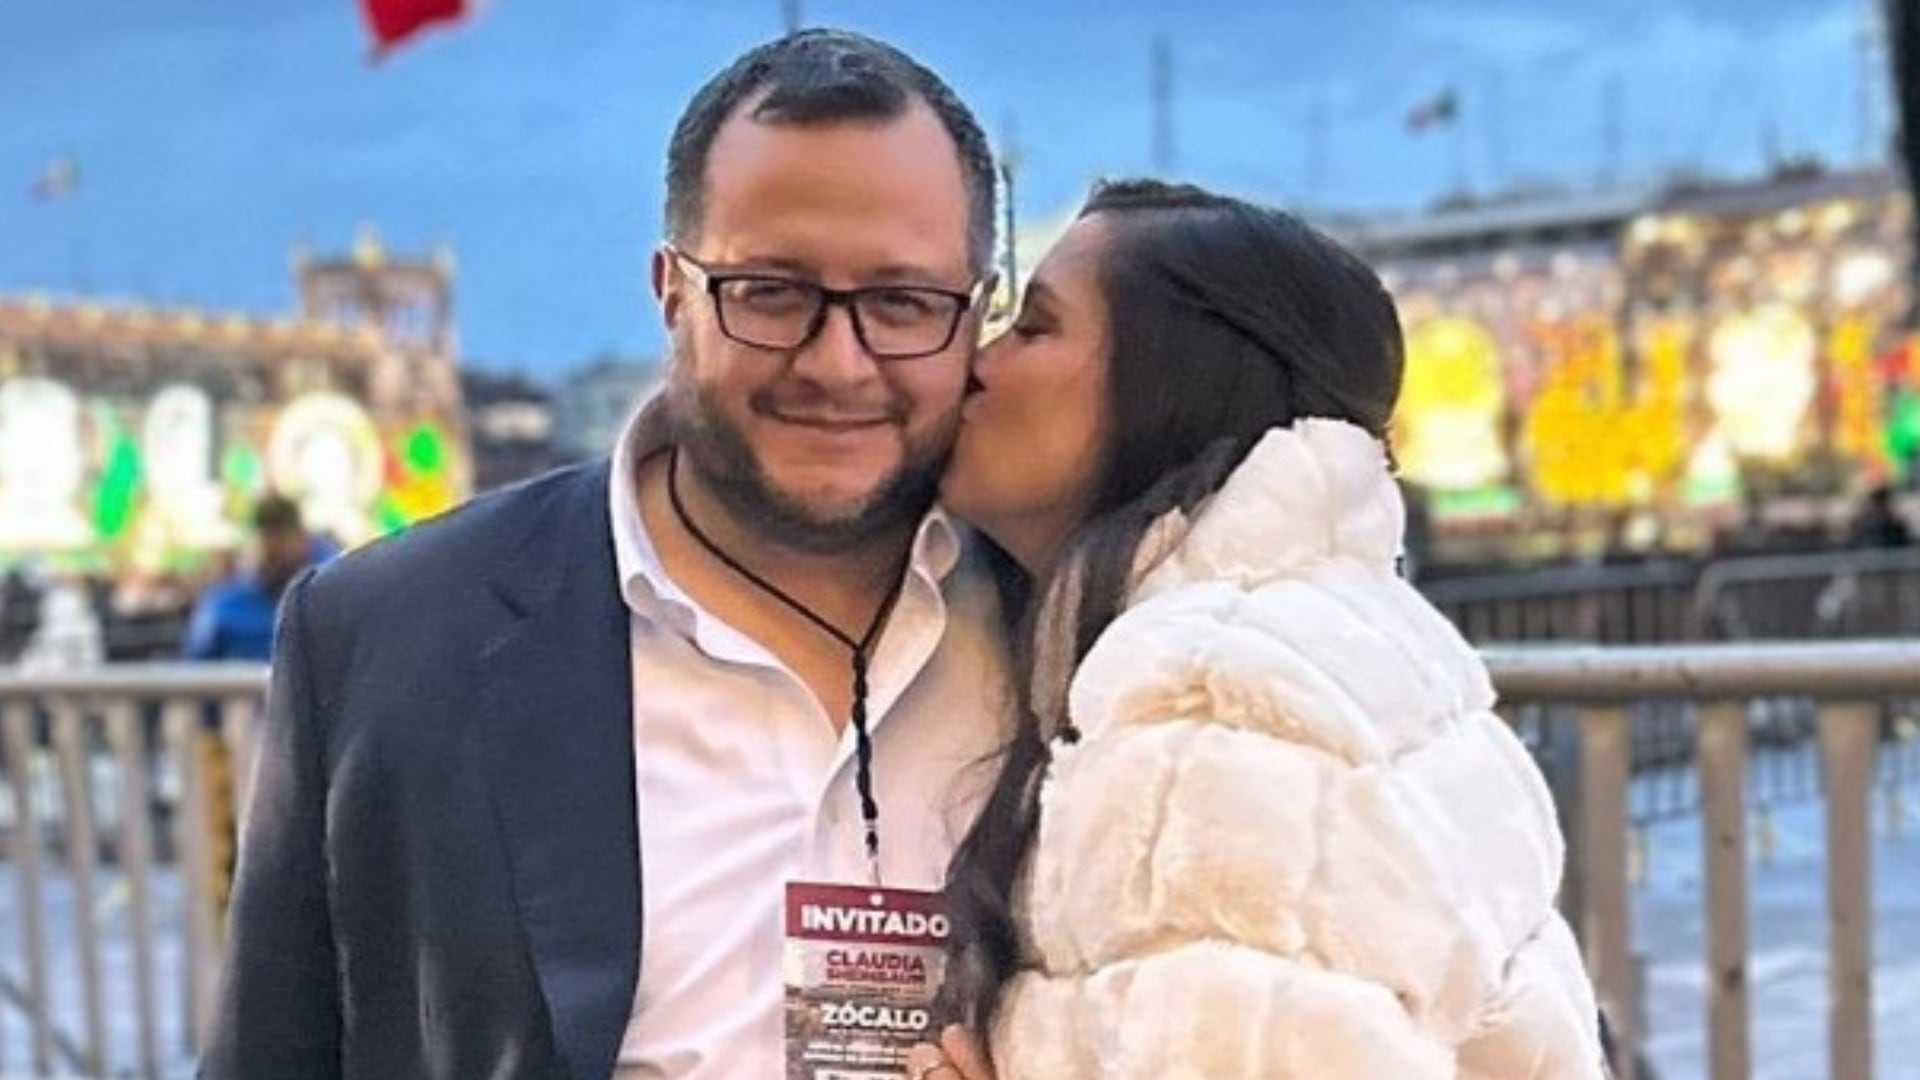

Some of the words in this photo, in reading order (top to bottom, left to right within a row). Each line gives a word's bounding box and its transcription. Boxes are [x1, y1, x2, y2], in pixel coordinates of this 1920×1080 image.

[801, 904, 949, 937] INVITADO
[826, 949, 924, 972] CLAUDIA
[821, 1001, 928, 1030] ZÓCALO
